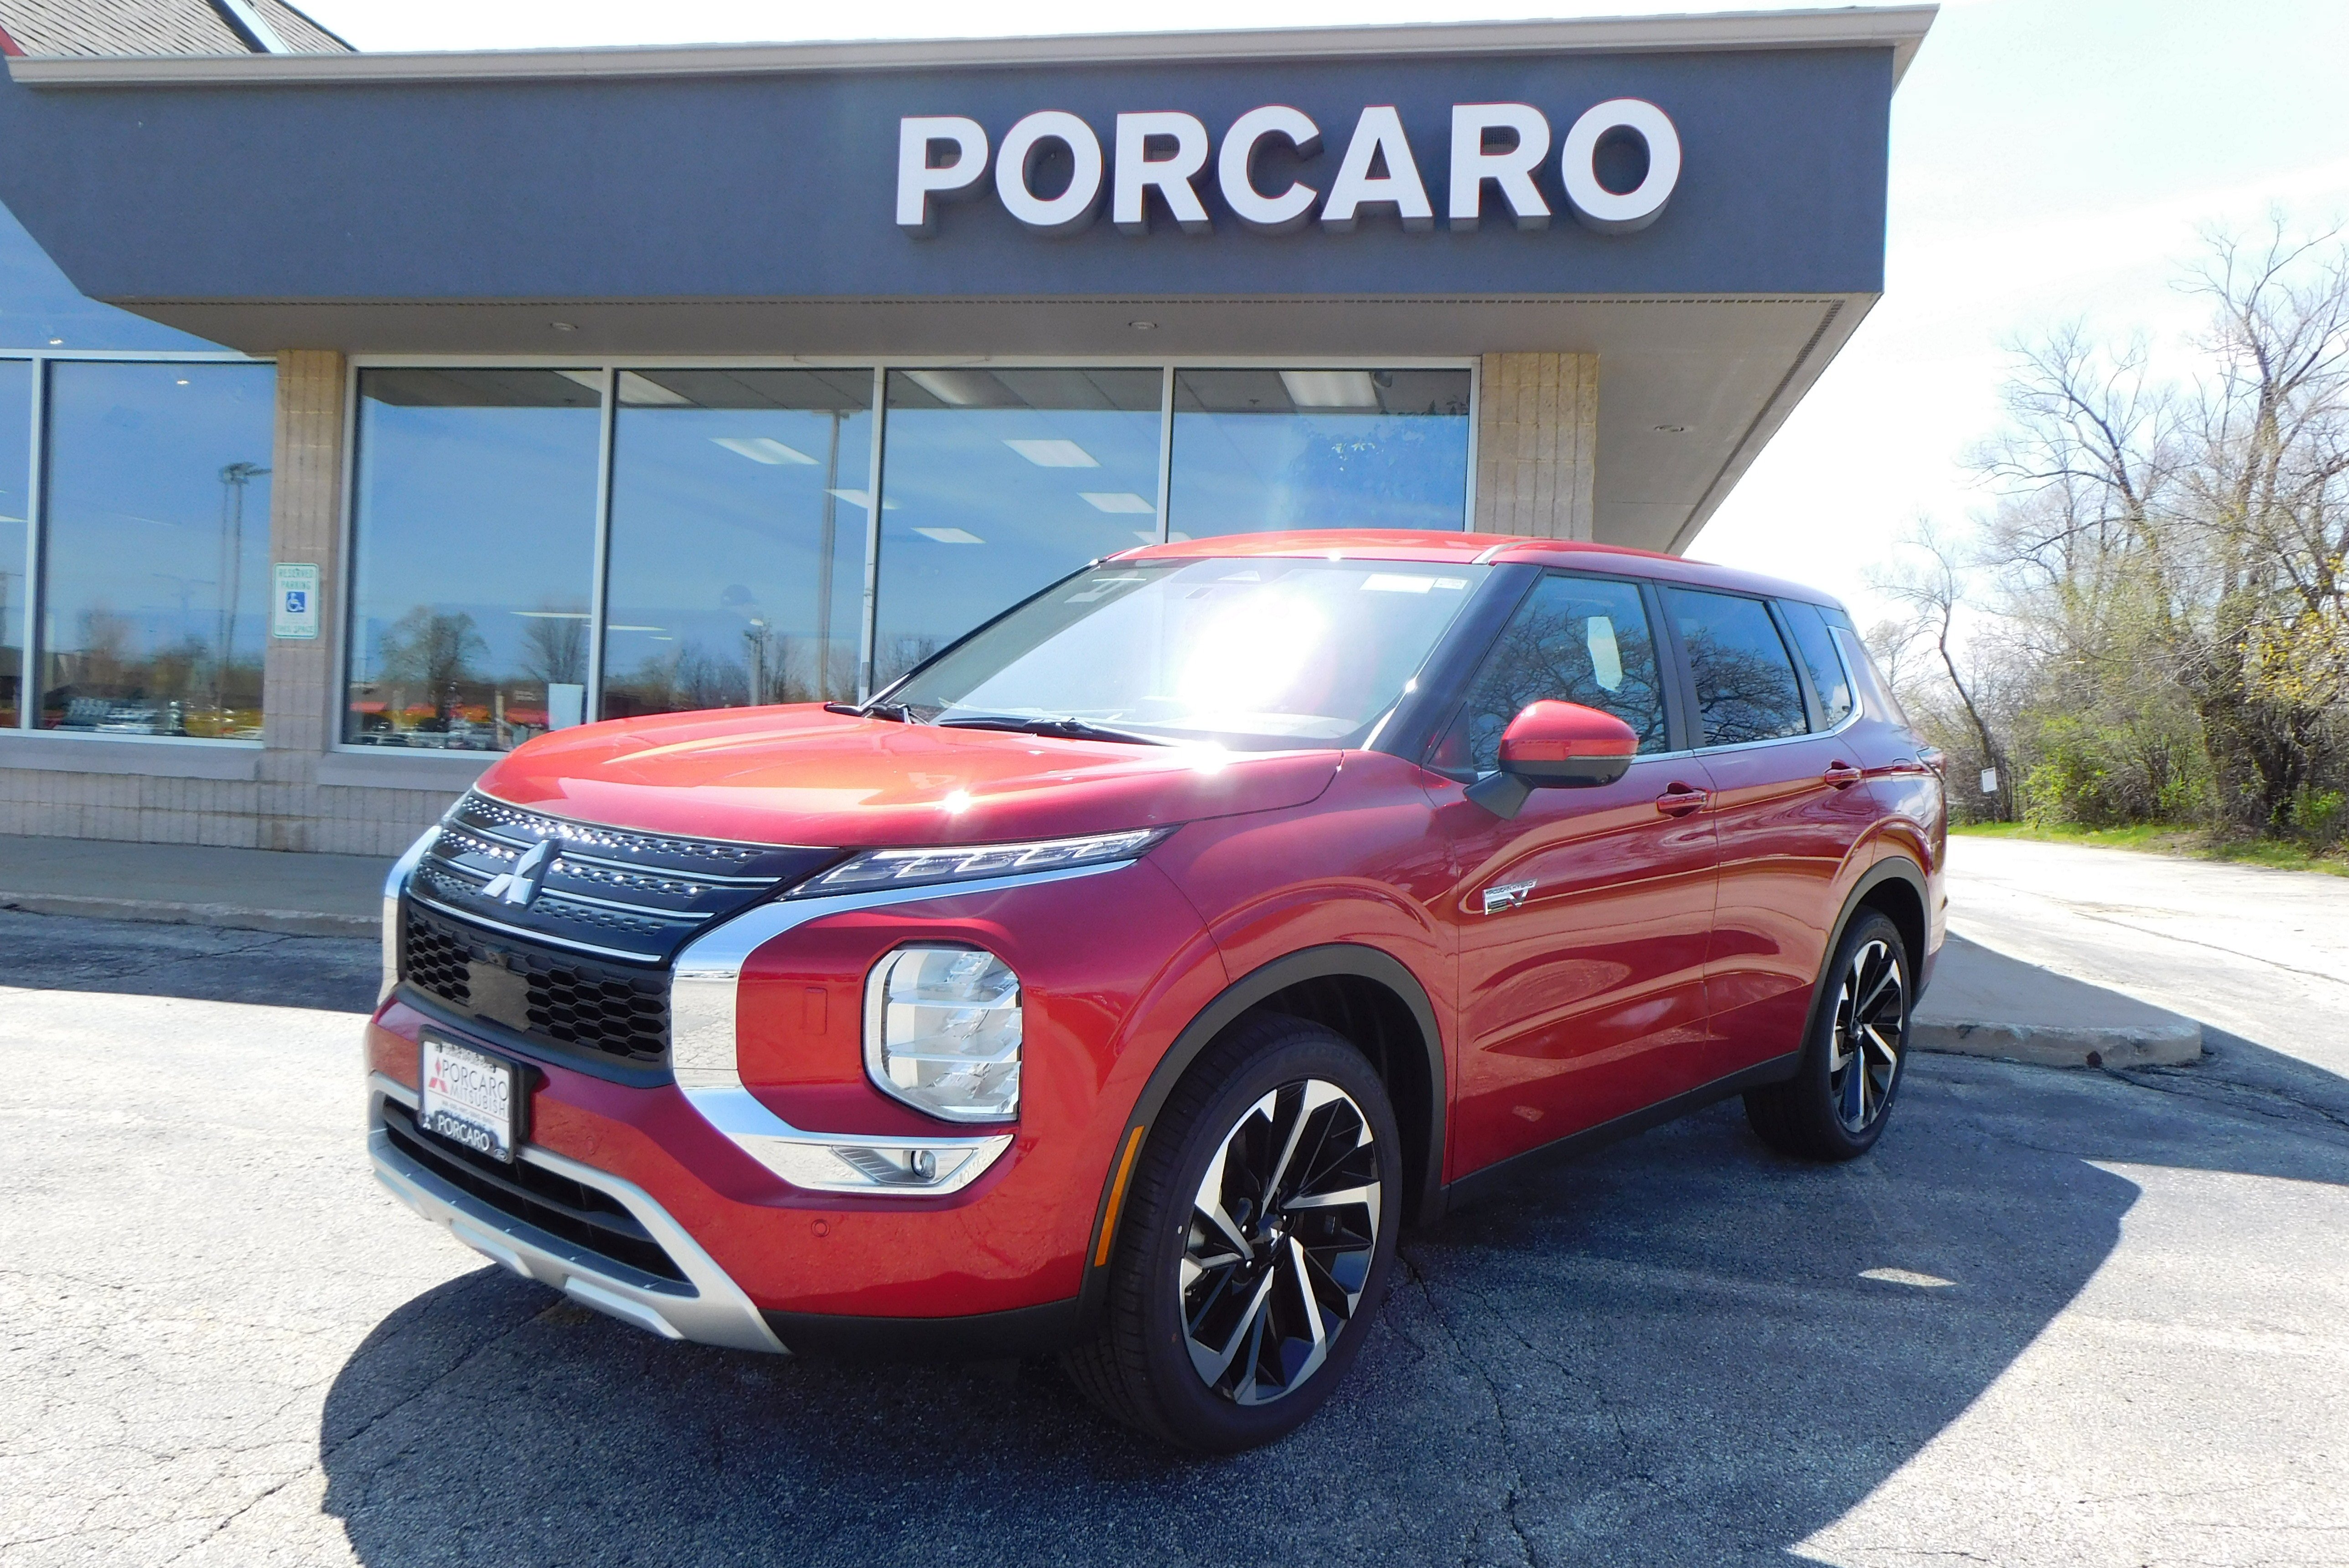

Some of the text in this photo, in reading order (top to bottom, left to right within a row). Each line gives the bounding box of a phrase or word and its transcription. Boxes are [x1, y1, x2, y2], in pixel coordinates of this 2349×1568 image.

[896, 98, 1682, 227] PORCARO
[278, 568, 313, 578] RESERVED
[281, 580, 311, 590] PARKING
[442, 1059, 508, 1101] PORCARO
[438, 1115, 490, 1151] PORCARO
